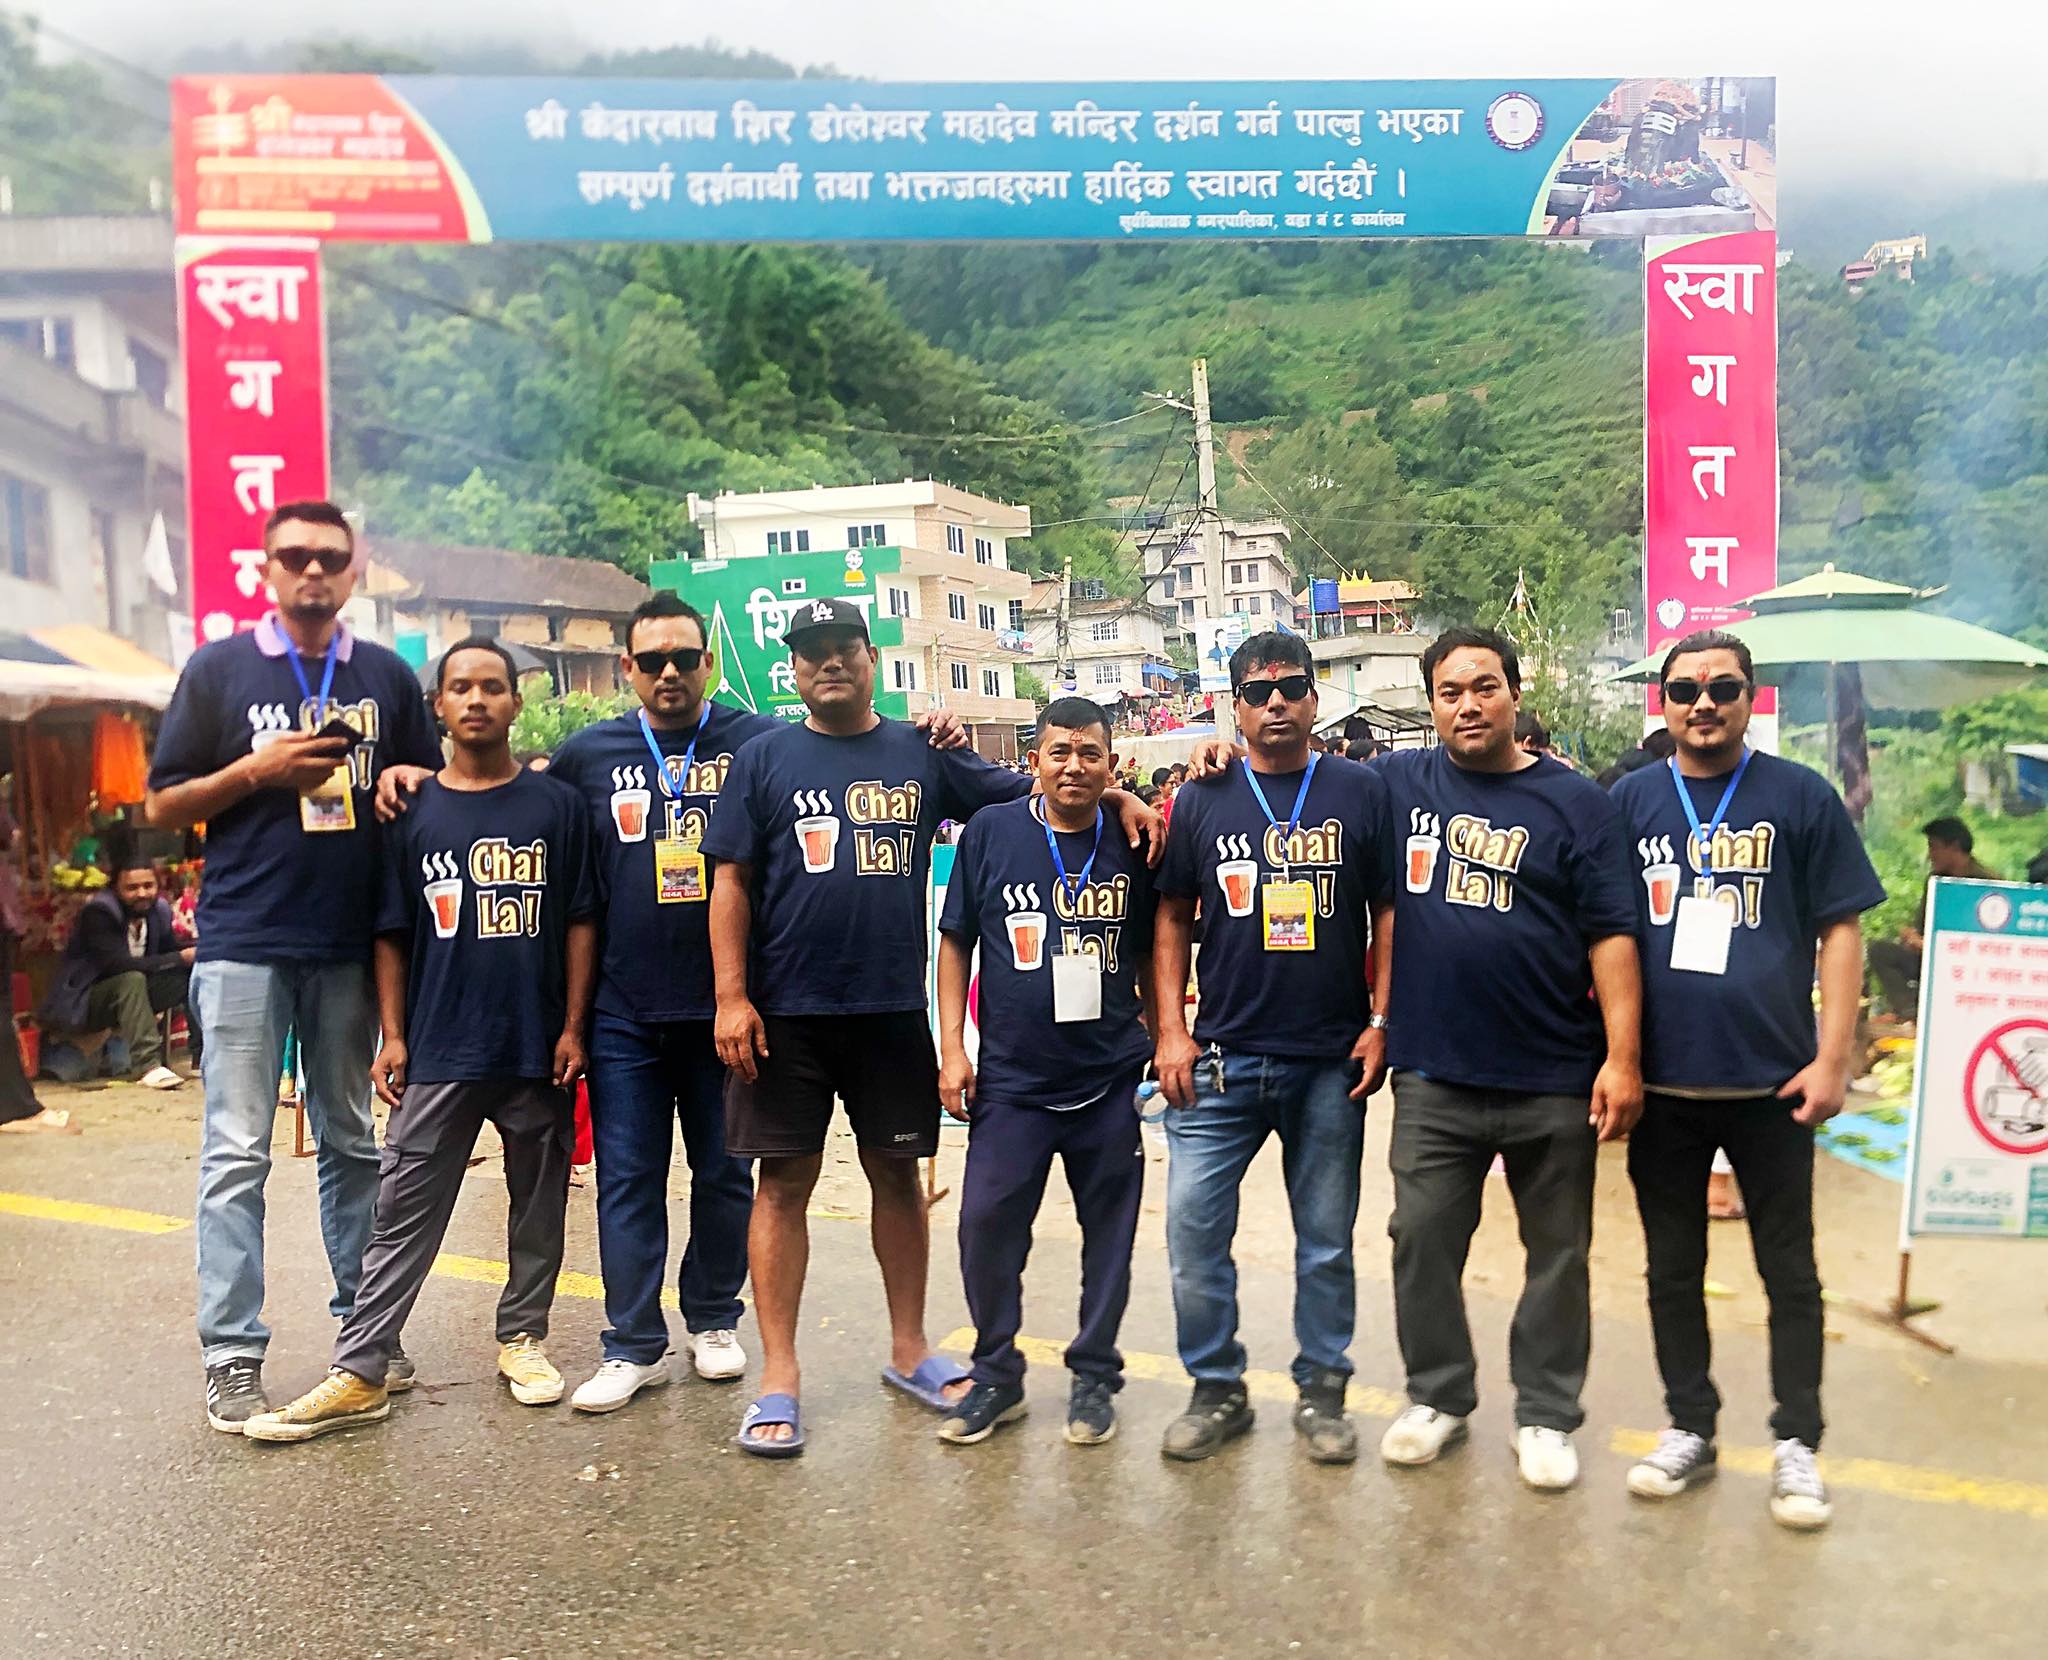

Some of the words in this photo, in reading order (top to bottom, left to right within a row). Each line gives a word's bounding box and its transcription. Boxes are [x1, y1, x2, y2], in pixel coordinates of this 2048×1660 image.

[526, 99, 568, 140] श्री
[732, 100, 795, 144] शिर
[943, 102, 1038, 144] महादेव
[1049, 100, 1142, 143] मन्दिर
[1153, 101, 1223, 142] दर्शन
[1235, 100, 1282, 136] गर्न
[1294, 109, 1365, 146] पाल्नु
[1376, 108, 1464, 143] भएका
[577, 162, 675, 211] सम्पूर्ण
[814, 171, 874, 202] तथा
[1083, 160, 1174, 205] हार्दिक
[1185, 169, 1283, 201] स्वागत
[1351, 210, 1406, 227] कार्यालय
[845, 780, 921, 825] Chai
[468, 837, 547, 886] Chai
[853, 829, 915, 877] La!
[1263, 818, 1343, 868] Chai
[1446, 814, 1529, 874] Chai
[1687, 821, 1776, 874] Chai
[1052, 873, 1130, 921] Chai
[1445, 857, 1512, 912] La!
[476, 889, 542, 939] La!
